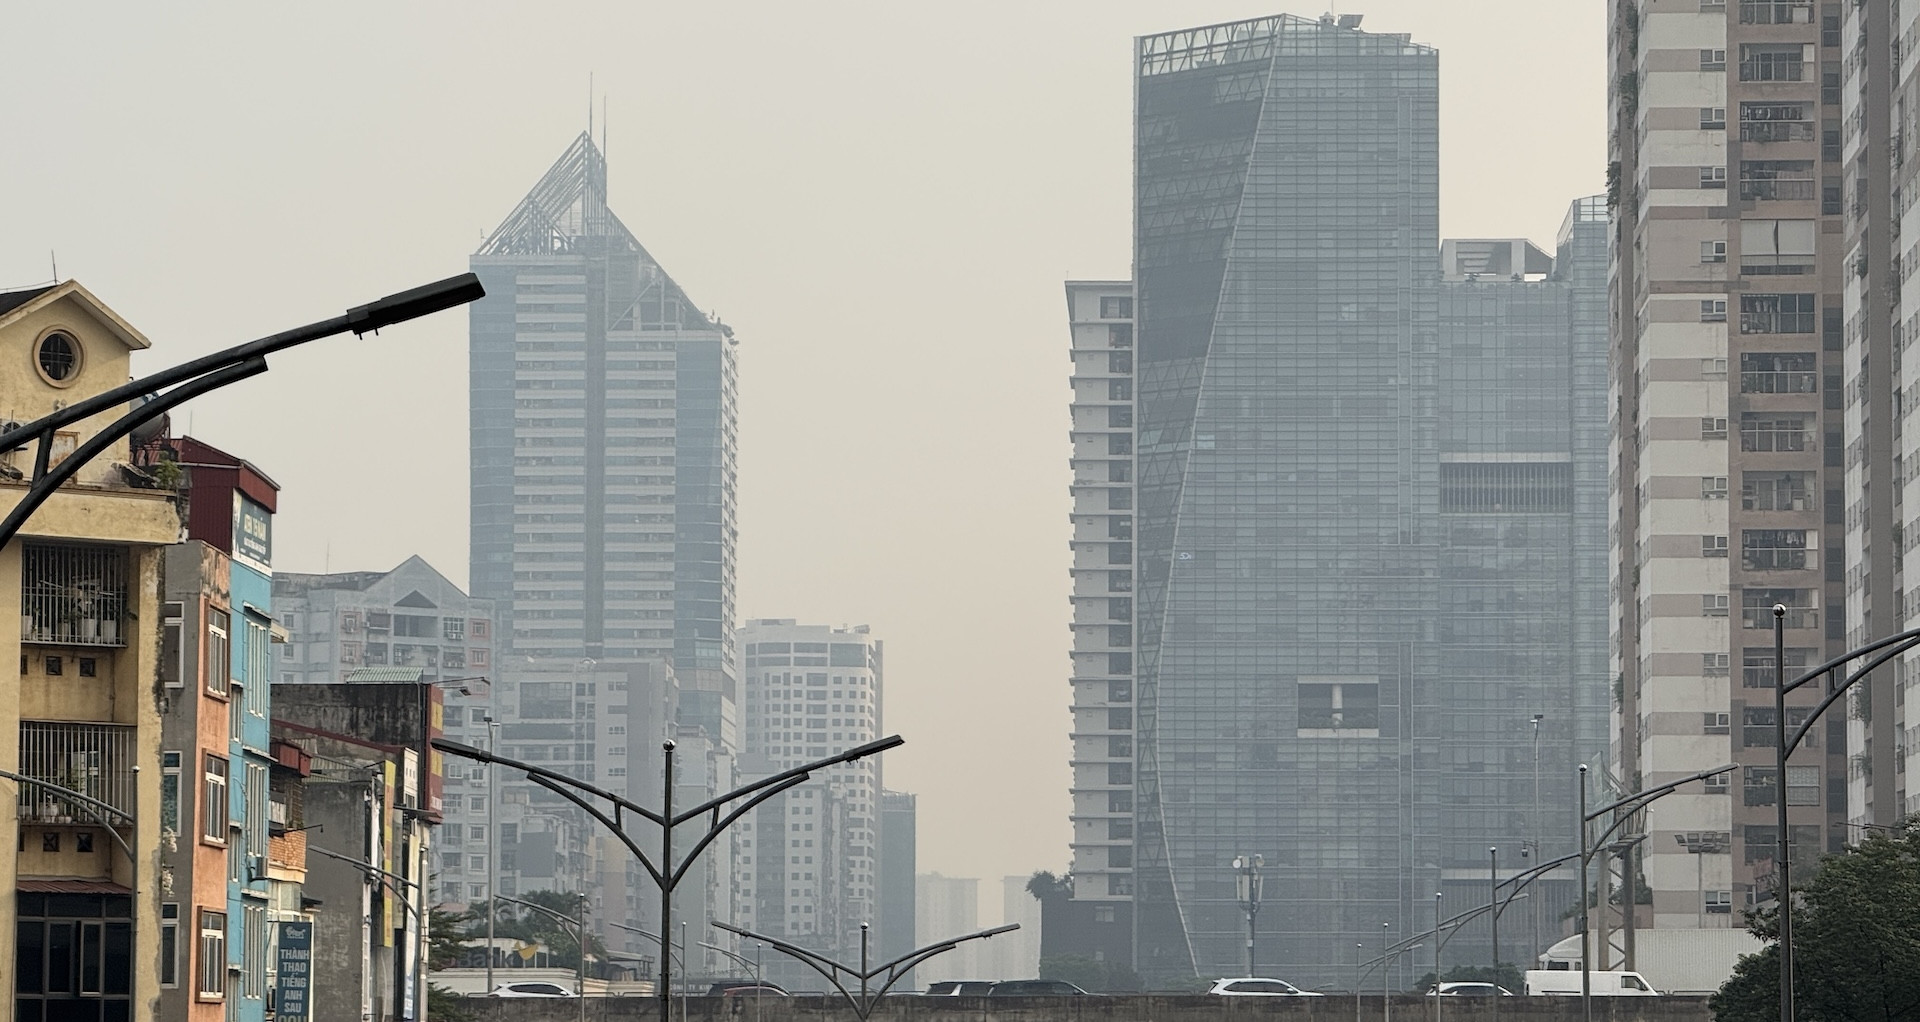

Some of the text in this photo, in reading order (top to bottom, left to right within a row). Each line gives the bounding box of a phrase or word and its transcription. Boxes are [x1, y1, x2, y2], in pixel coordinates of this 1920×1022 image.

[280, 947, 310, 960] THÀNH
[281, 973, 306, 988] TIẾNG
[284, 990, 302, 1000] ANH
[284, 1002, 302, 1013] SAU
